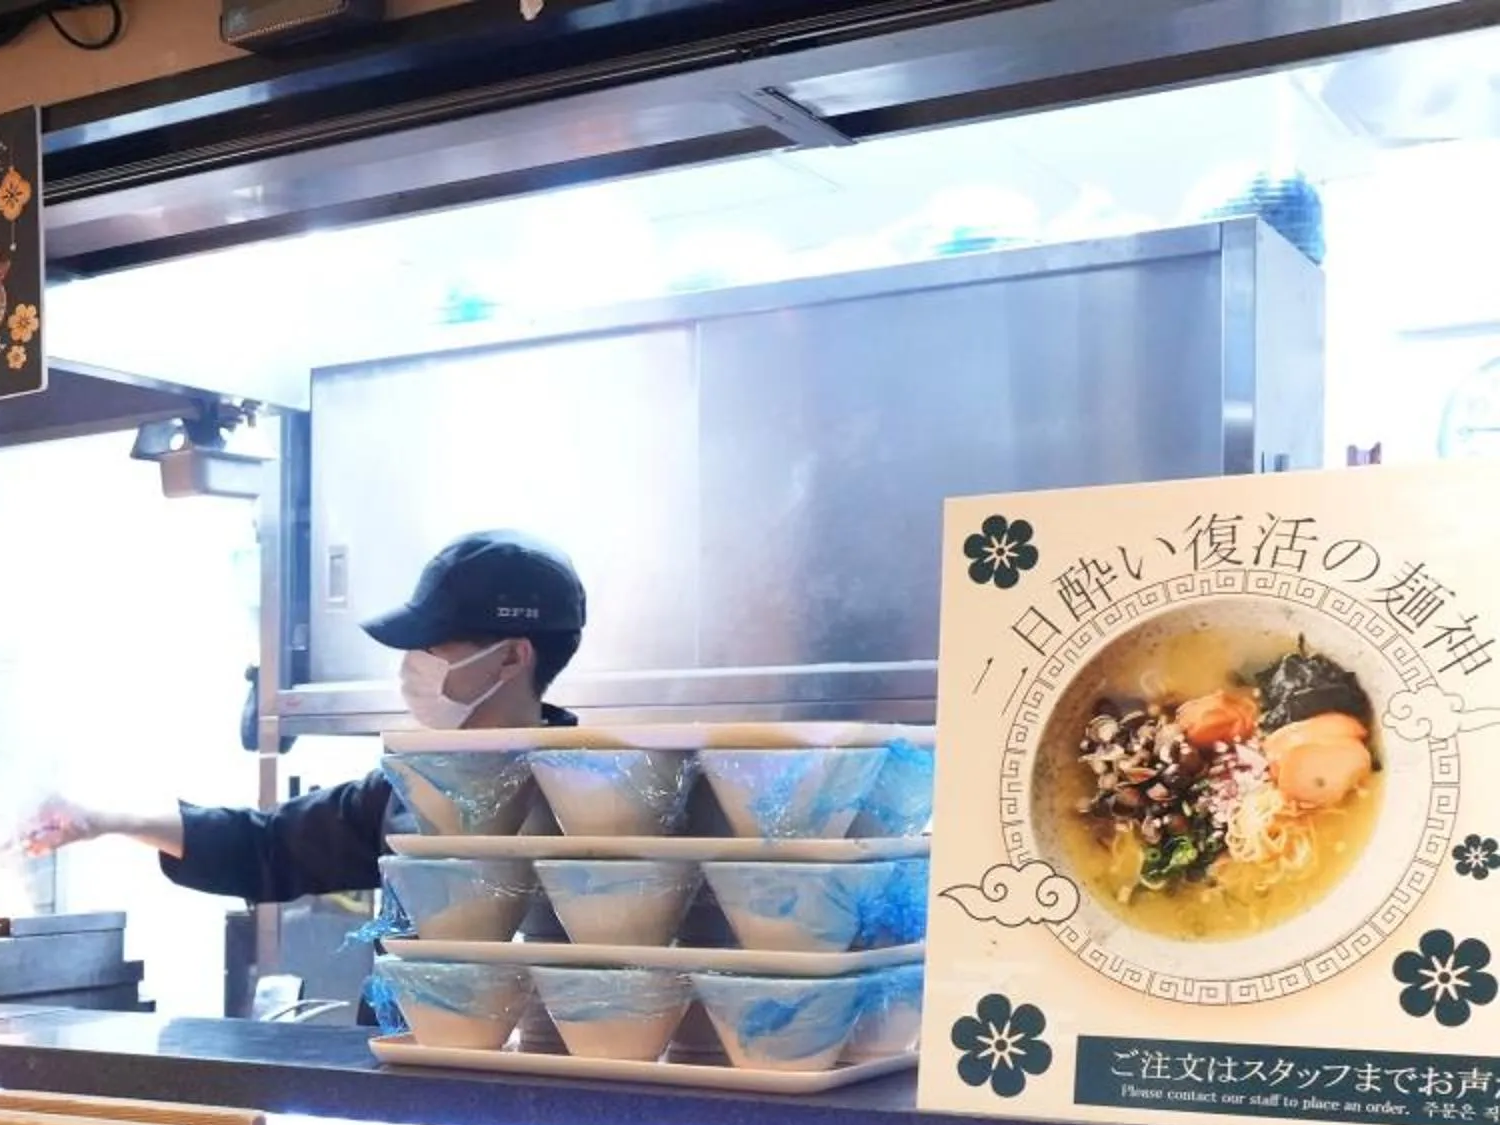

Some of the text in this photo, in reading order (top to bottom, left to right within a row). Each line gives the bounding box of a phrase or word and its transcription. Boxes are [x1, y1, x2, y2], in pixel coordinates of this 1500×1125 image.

[972, 511, 1496, 718] 二日酔い復活の麺神
[1110, 1048, 1500, 1099] ご注文はスタッフまでお声
[1121, 1083, 1164, 1100] Please
[1167, 1088, 1217, 1103] contact
[1221, 1092, 1247, 1104] our
[1249, 1091, 1280, 1107] staff
[1283, 1095, 1299, 1108] to
[1302, 1096, 1341, 1113] place
[1343, 1101, 1363, 1112] an
[1365, 1100, 1411, 1116] order.
[1422, 1100, 1477, 1121] 주문은
